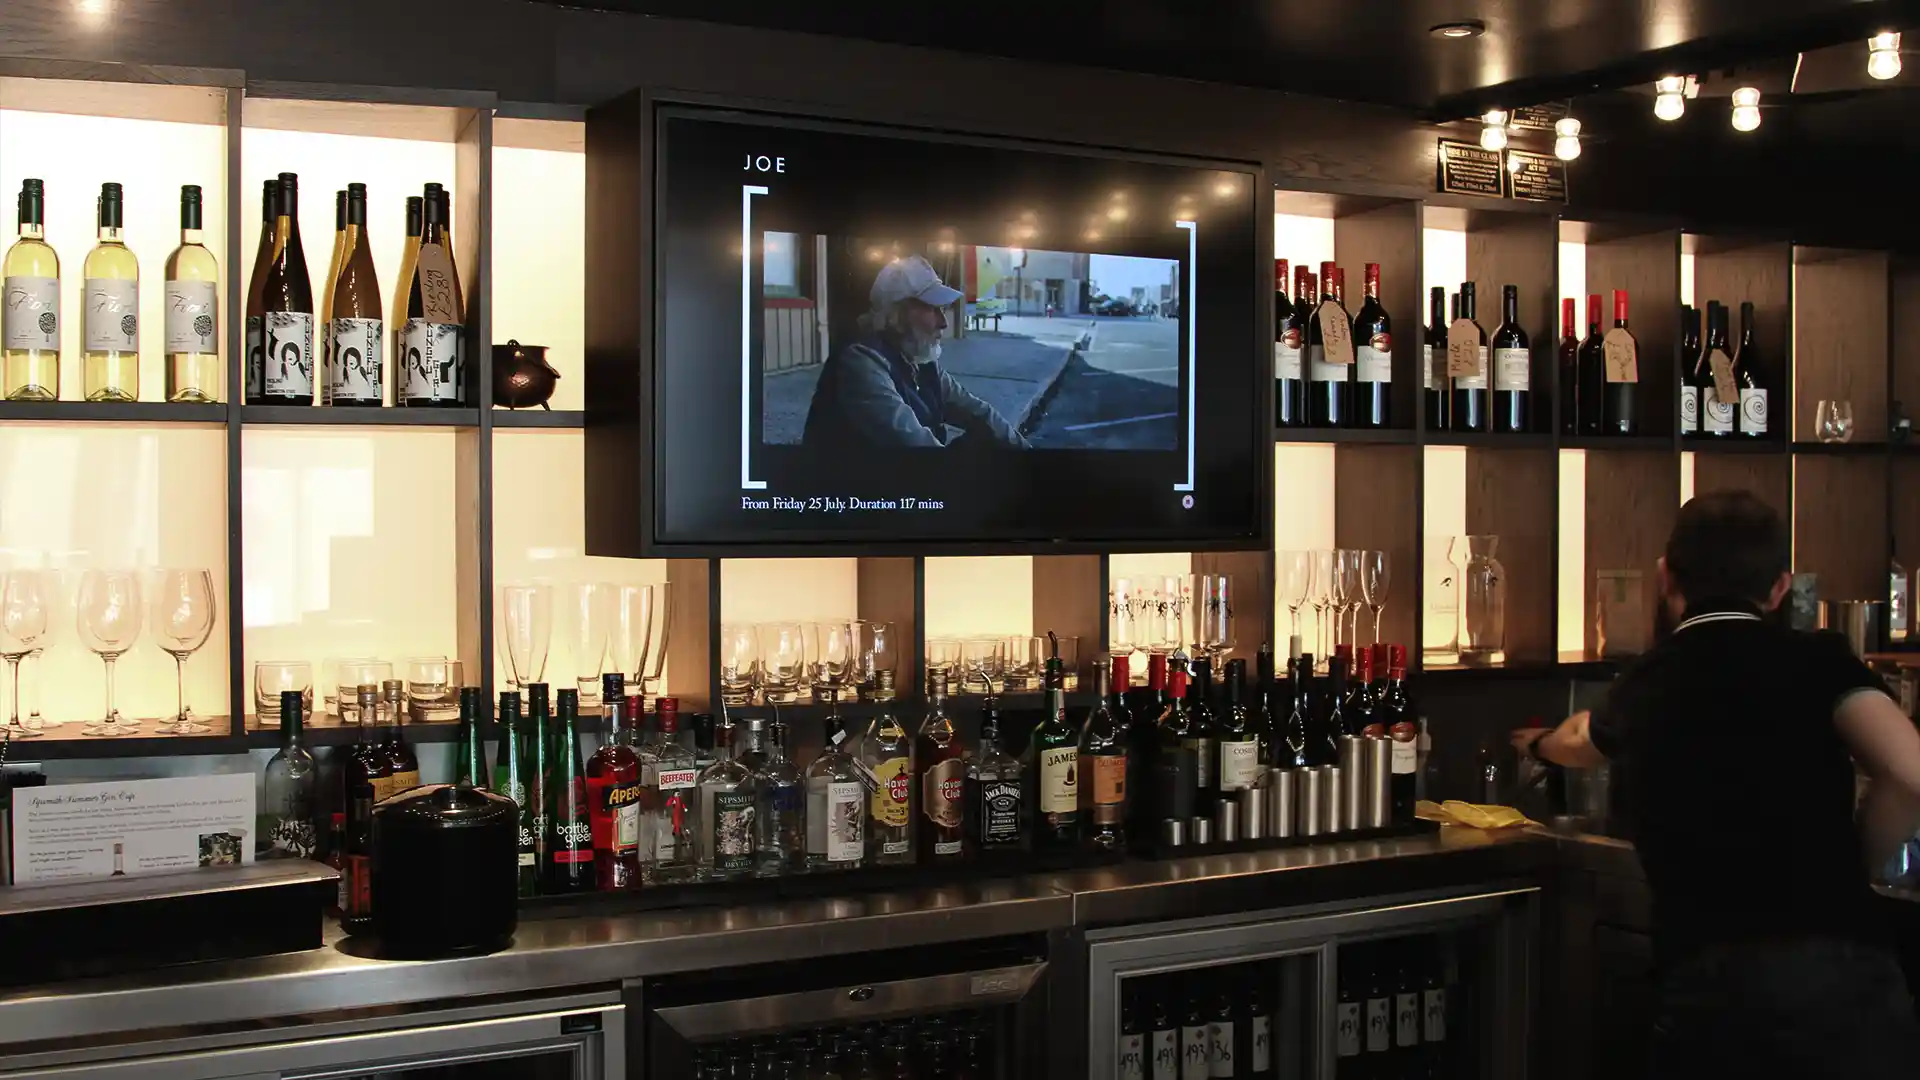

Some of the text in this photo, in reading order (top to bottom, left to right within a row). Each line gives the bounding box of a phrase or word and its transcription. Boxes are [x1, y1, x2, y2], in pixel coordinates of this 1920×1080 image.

[743, 154, 785, 173] JOE
[742, 497, 769, 509] From
[772, 497, 806, 512] Friday
[808, 498, 822, 509] 25
[849, 498, 896, 509] Duration
[900, 498, 916, 509] 117
[918, 499, 944, 509] mins
[1048, 752, 1077, 766] JAMES
[660, 772, 694, 786] BEEFEATER
[609, 786, 640, 804] APER
[985, 788, 1000, 801] JACK
[556, 822, 589, 836] bottle
